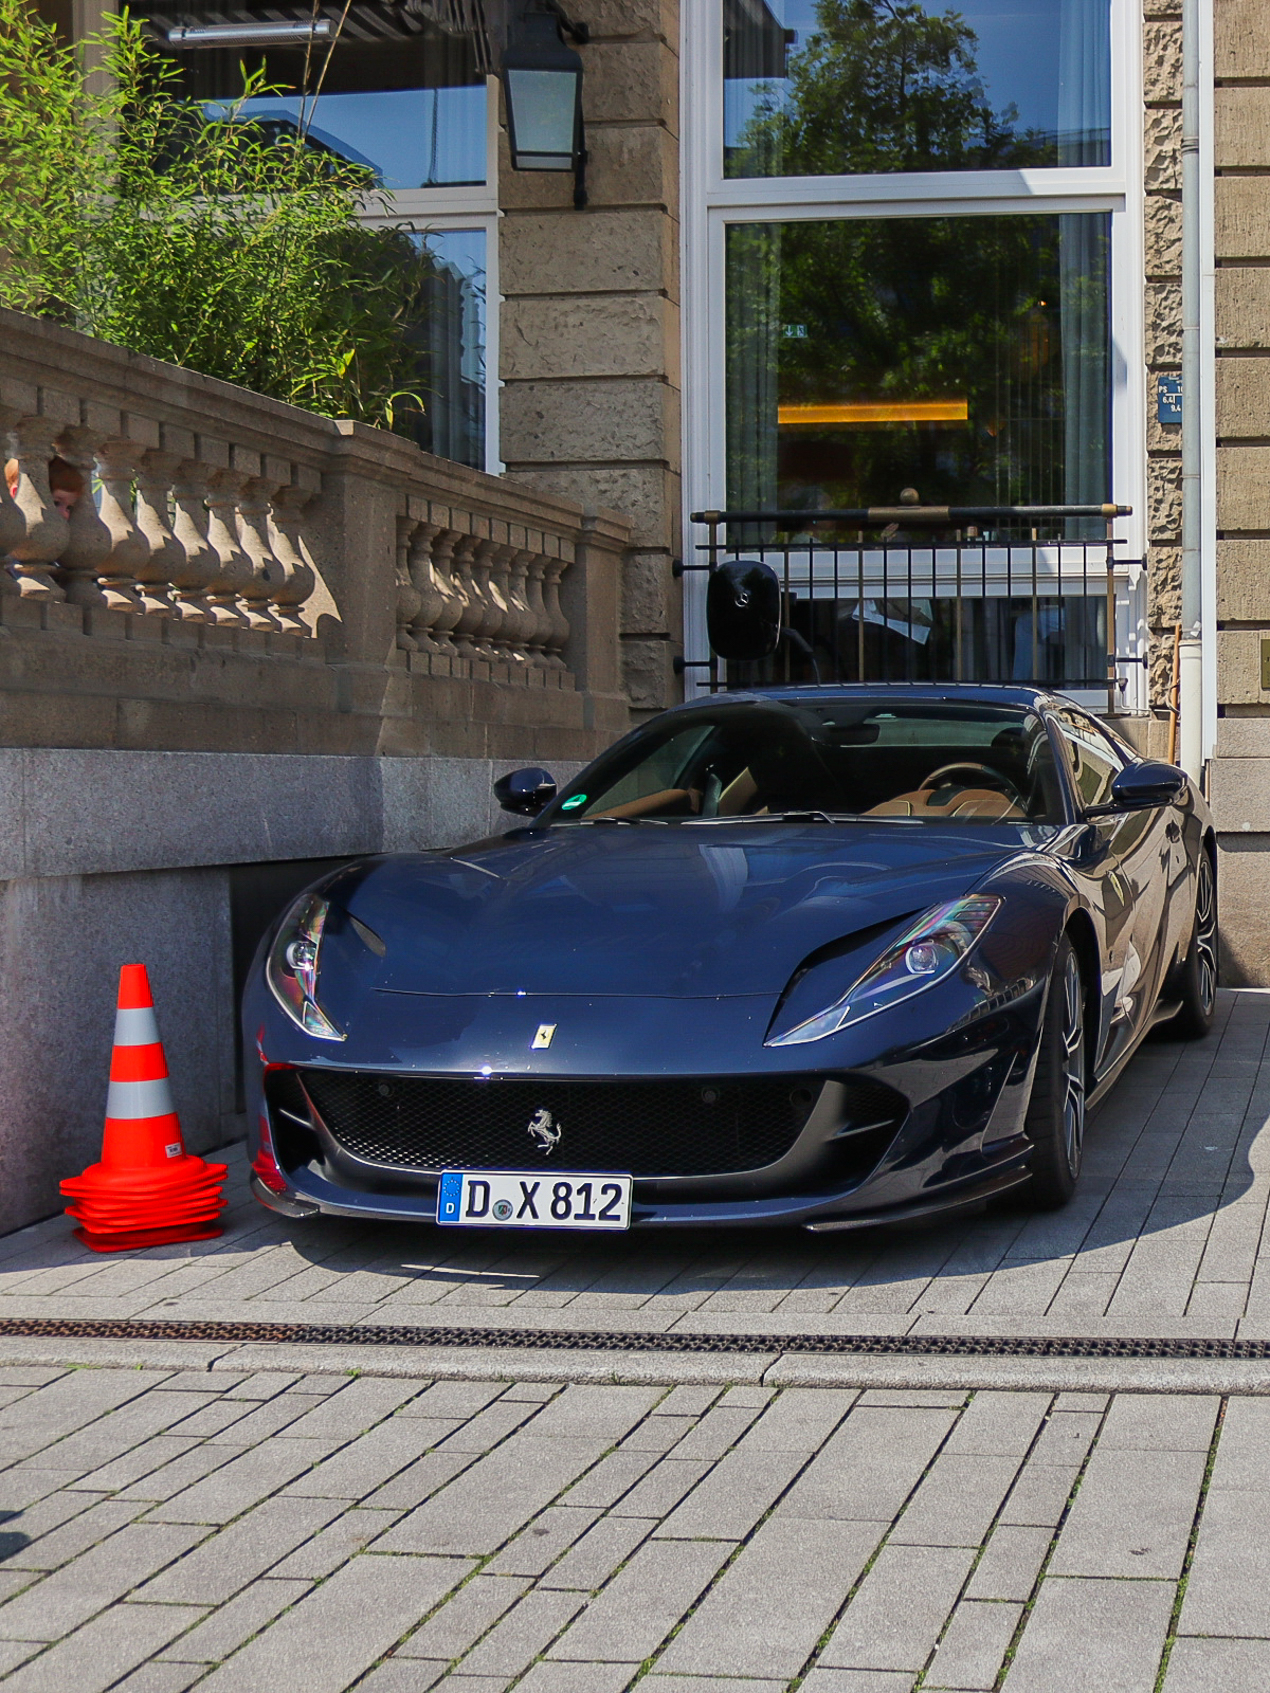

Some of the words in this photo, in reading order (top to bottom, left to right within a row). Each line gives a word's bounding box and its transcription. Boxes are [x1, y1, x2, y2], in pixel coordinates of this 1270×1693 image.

[1158, 385, 1168, 393] PS
[465, 1180, 491, 1218] D
[516, 1181, 541, 1220] X
[550, 1182, 623, 1221] 812
[445, 1202, 455, 1214] D
